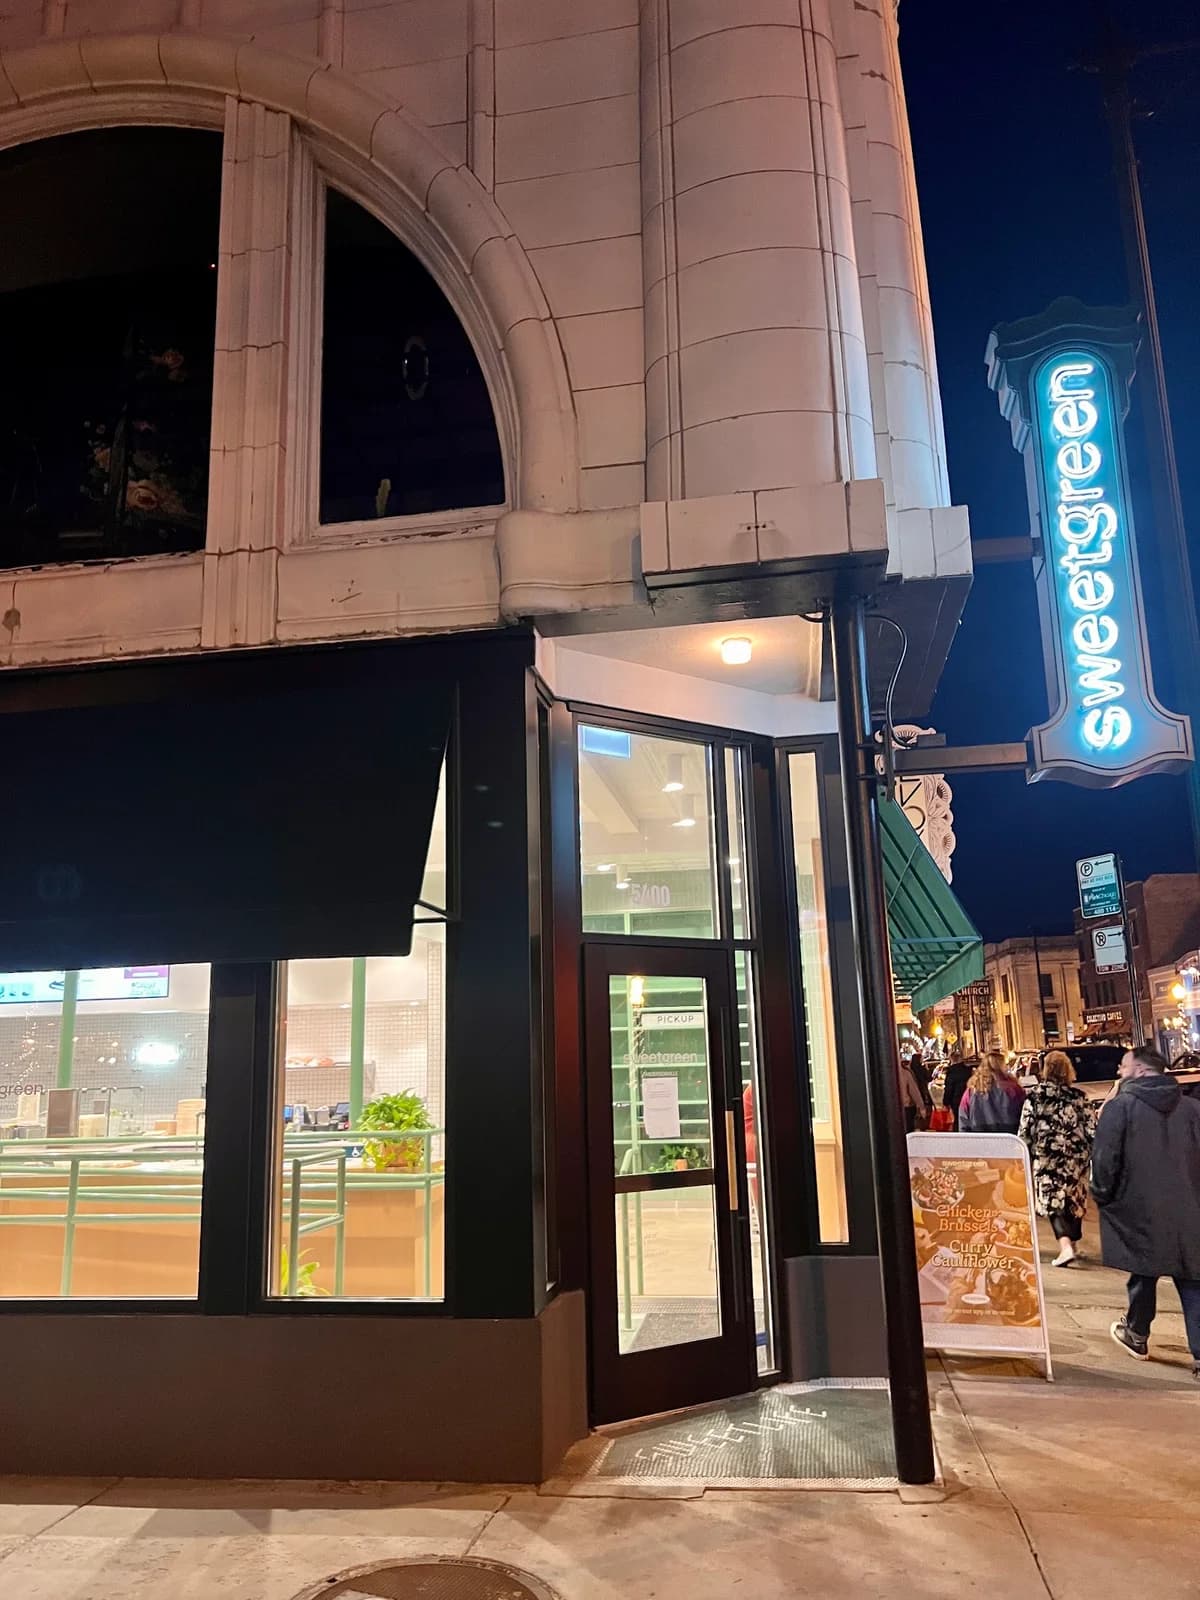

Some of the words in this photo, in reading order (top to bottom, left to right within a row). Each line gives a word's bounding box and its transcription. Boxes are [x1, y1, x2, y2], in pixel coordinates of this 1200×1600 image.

[1049, 363, 1132, 749] sweetgreen
[631, 882, 671, 906] 5400
[956, 986, 990, 996] CHURCH
[657, 1015, 694, 1024] PICKUP
[623, 1052, 697, 1065] sweetgreen
[936, 1204, 994, 1222] Chicken
[939, 1219, 998, 1234] Brussels
[949, 1239, 995, 1257] Curry
[931, 1252, 1015, 1269] Cauliflower
